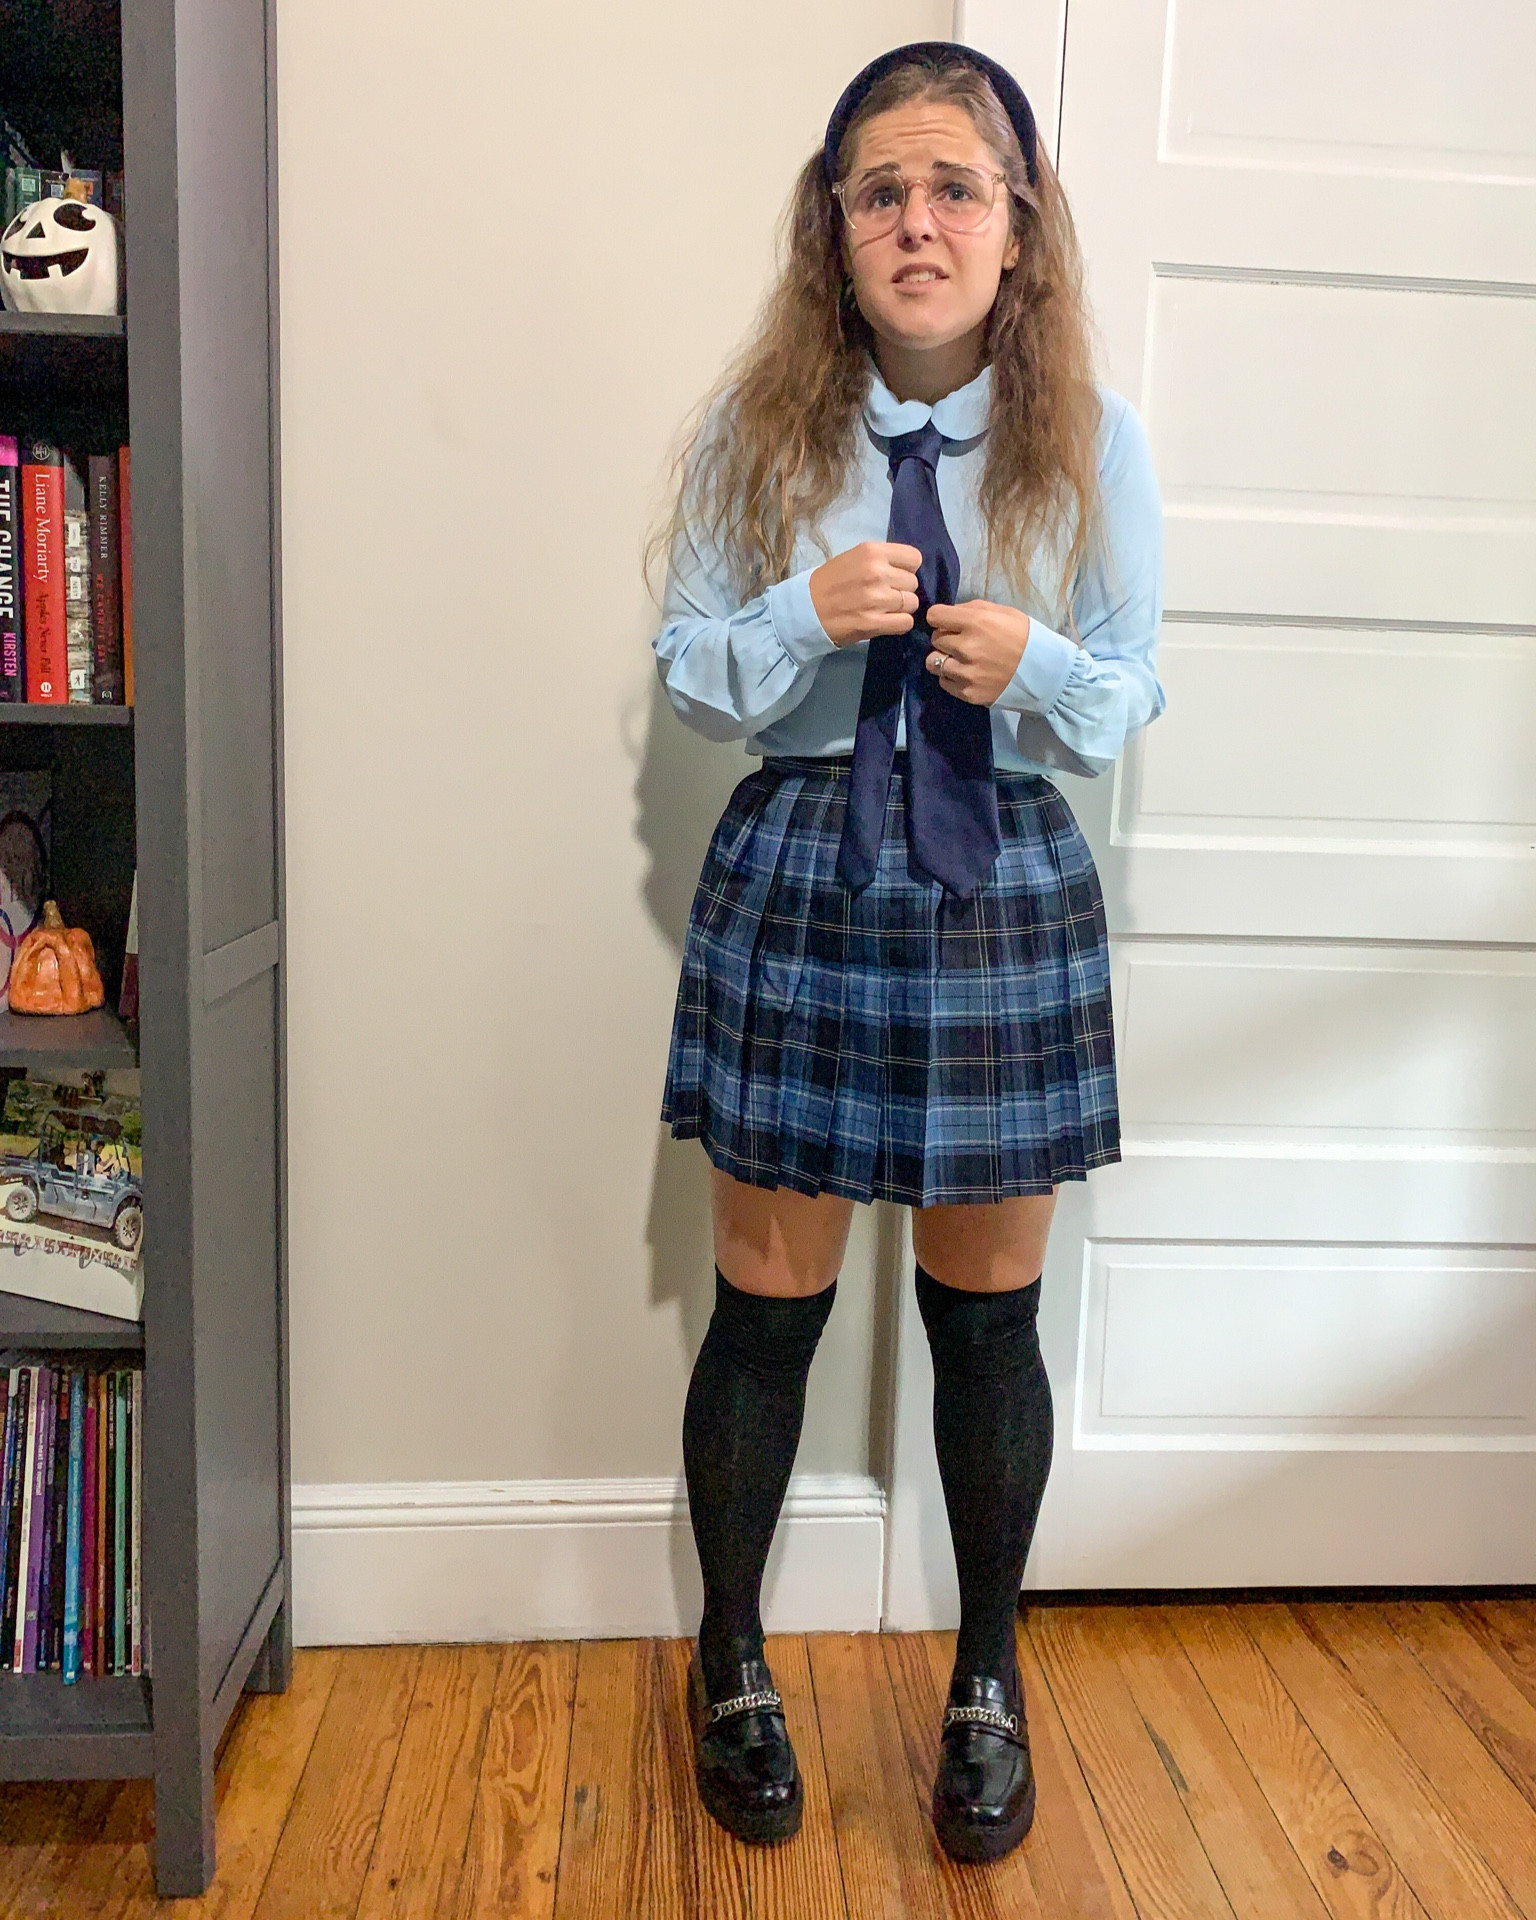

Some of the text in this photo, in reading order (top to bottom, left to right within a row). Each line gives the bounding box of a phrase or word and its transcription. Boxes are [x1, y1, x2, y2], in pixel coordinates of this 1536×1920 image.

[33, 472, 51, 583] Liane Moriarty
[98, 476, 108, 559] KELLY RIMMER
[3, 632, 17, 677] KIRSTEN
